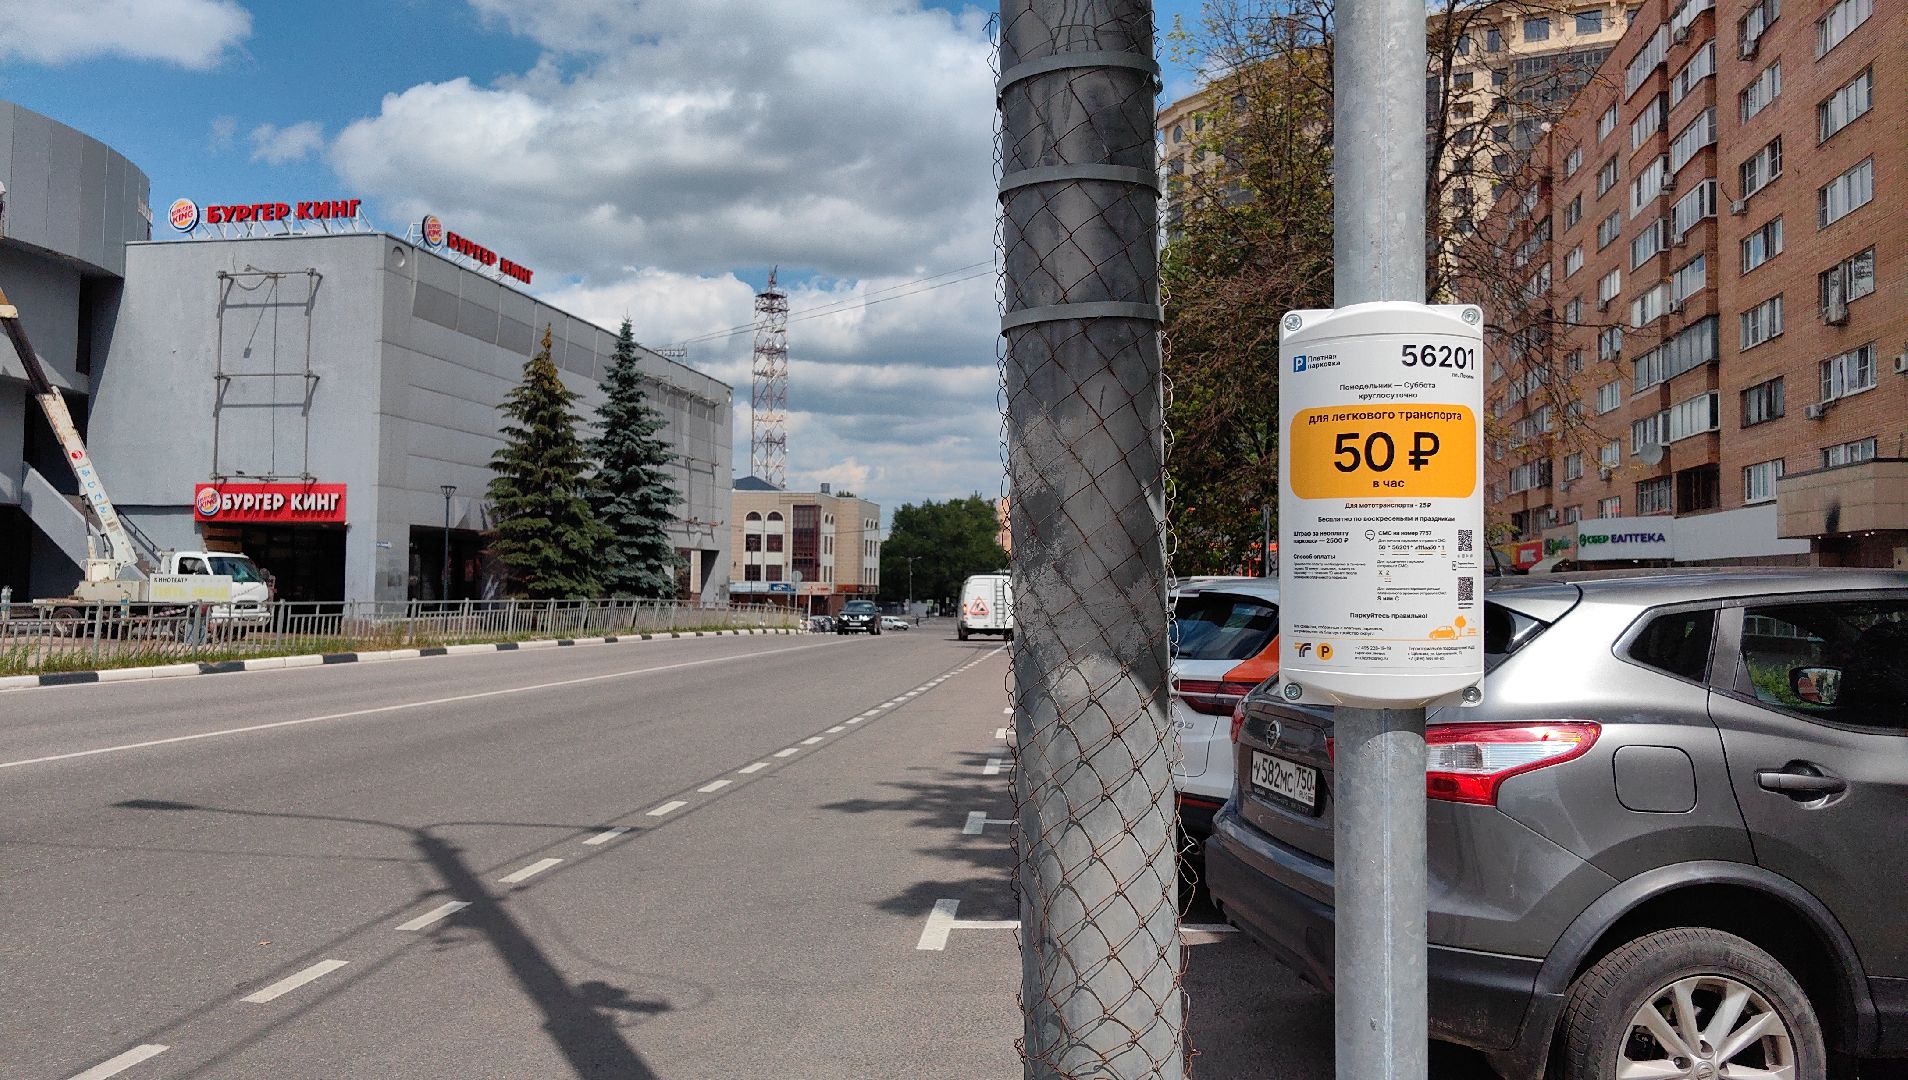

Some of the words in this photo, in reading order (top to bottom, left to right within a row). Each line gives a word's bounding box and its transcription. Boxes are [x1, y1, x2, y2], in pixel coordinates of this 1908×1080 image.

[172, 211, 193, 224] KING
[206, 203, 290, 223] БУРГЕР
[296, 200, 361, 220] КИНГ
[447, 231, 497, 266] БУРГЕР
[500, 257, 534, 284] КИНГ
[1401, 345, 1474, 370] 56201
[1307, 361, 1341, 370] парковка
[1339, 383, 1393, 391] Понедельник
[1403, 381, 1436, 390] Суббота
[1358, 393, 1418, 401] круглосуточно
[1308, 413, 1329, 425] для
[1331, 411, 1395, 422] легкового
[1398, 411, 1462, 422] транспорта
[1333, 432, 1395, 473] 50
[1408, 432, 1440, 471] ₽
[1372, 480, 1379, 488] в
[1383, 480, 1405, 488] час
[221, 493, 285, 511] БУРГЕР
[290, 493, 340, 511] КИНГ
[1586, 535, 1609, 544] СБЕР
[1349, 612, 1390, 620] Паркуйтесь
[1296, 766, 1312, 792] 750
